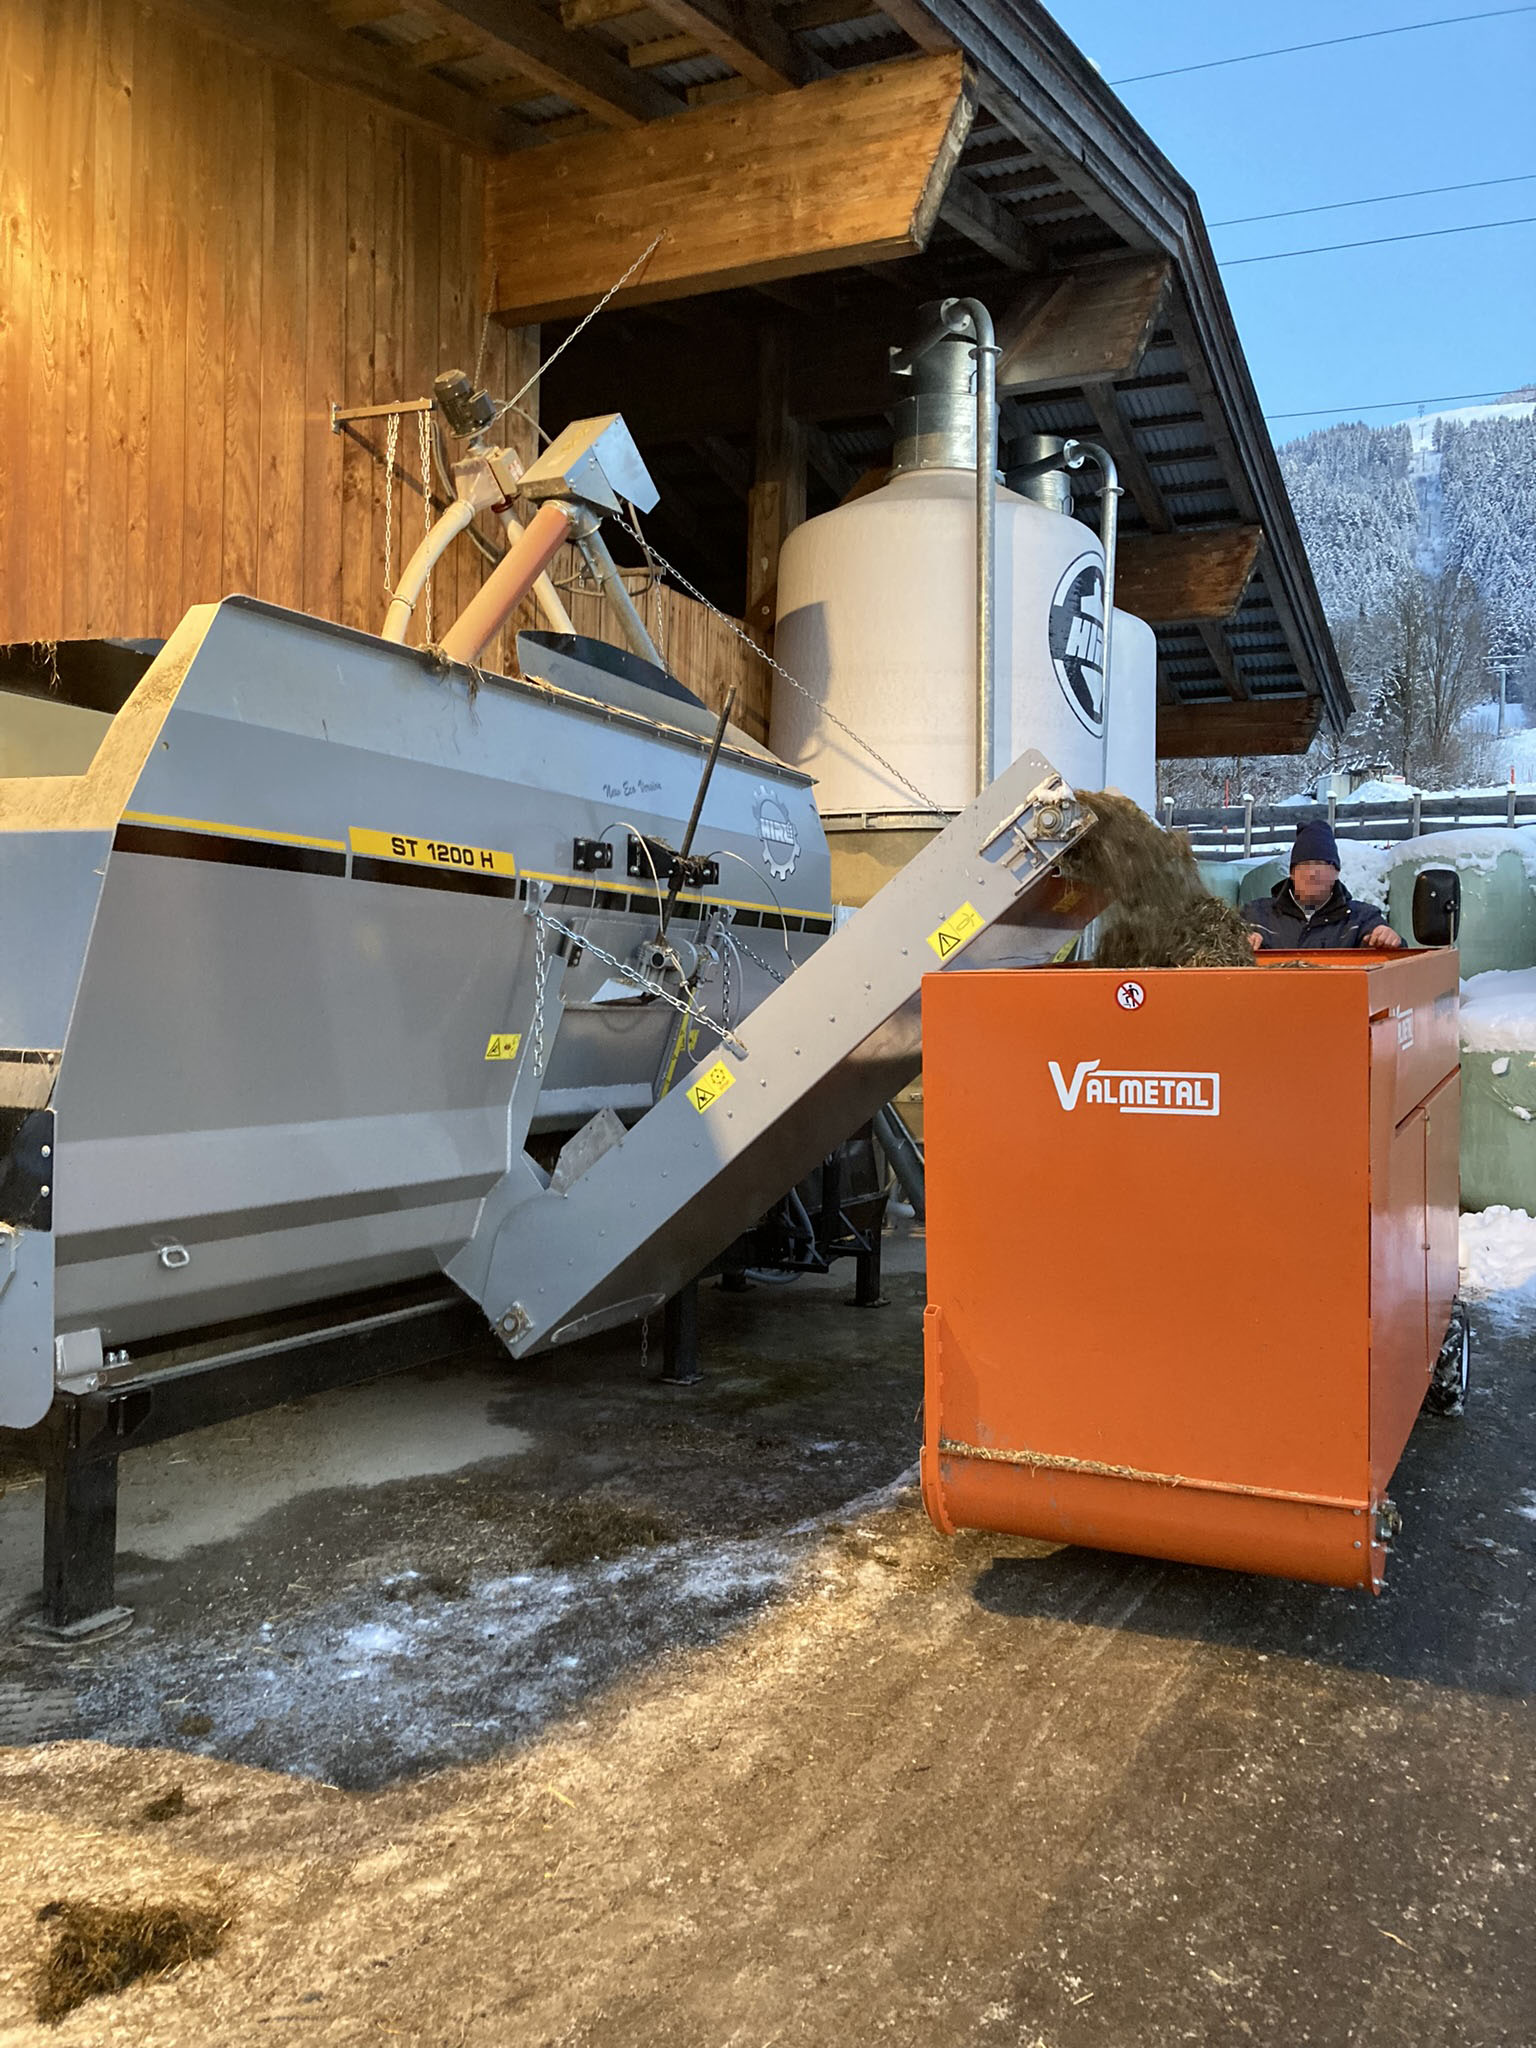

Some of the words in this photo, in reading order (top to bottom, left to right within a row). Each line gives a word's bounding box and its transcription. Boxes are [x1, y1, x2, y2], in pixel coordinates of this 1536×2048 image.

[391, 836, 418, 858] ST
[427, 842, 475, 867] 1200
[480, 850, 494, 869] H
[1047, 1058, 1210, 1112] VALMETAL
